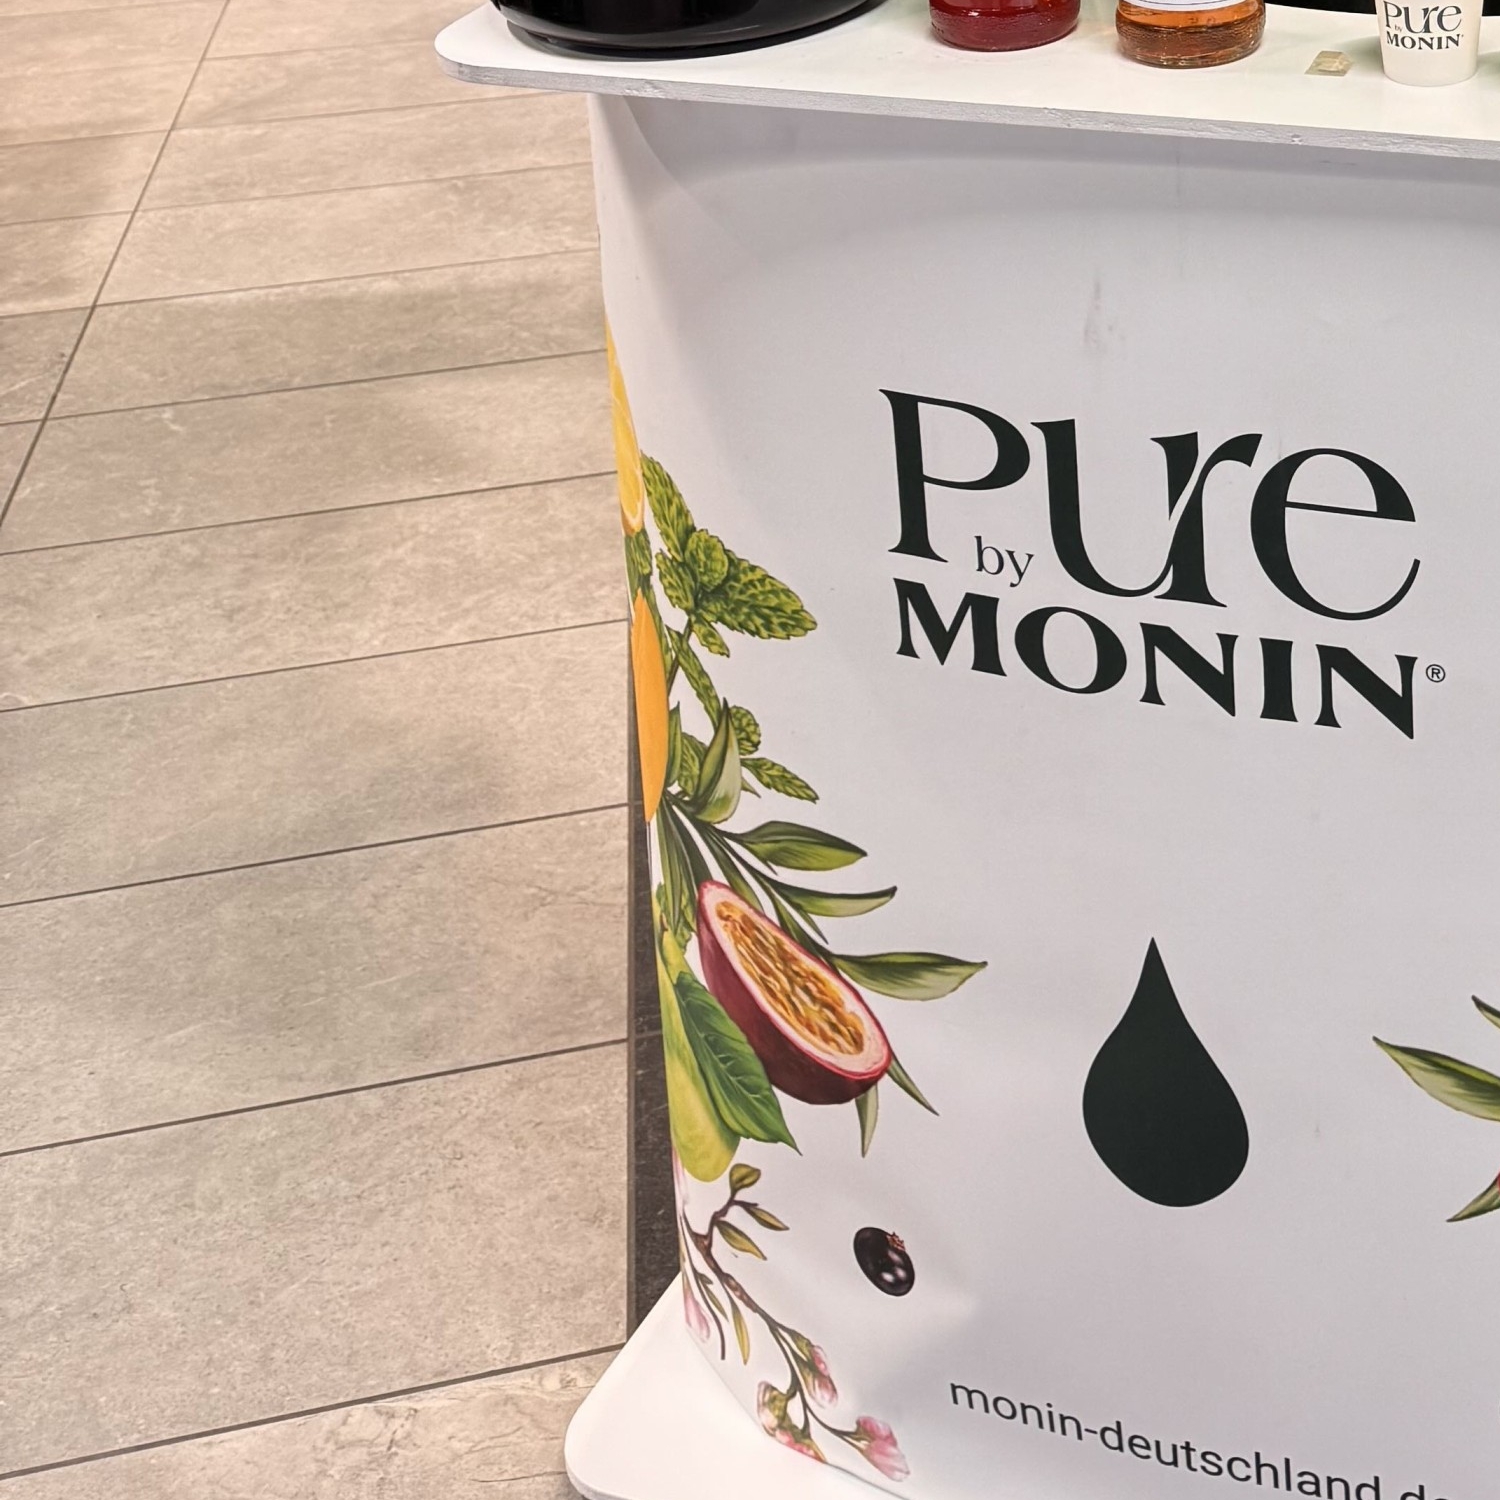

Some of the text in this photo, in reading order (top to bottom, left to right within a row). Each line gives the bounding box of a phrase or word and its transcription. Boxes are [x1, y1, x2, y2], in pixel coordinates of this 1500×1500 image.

[1383, 1, 1462, 34] Pure
[1386, 31, 1461, 50] MONIN
[878, 388, 1420, 621] Pure
[974, 536, 1034, 587] by
[949, 1382, 1448, 1500] monin-deutschland
